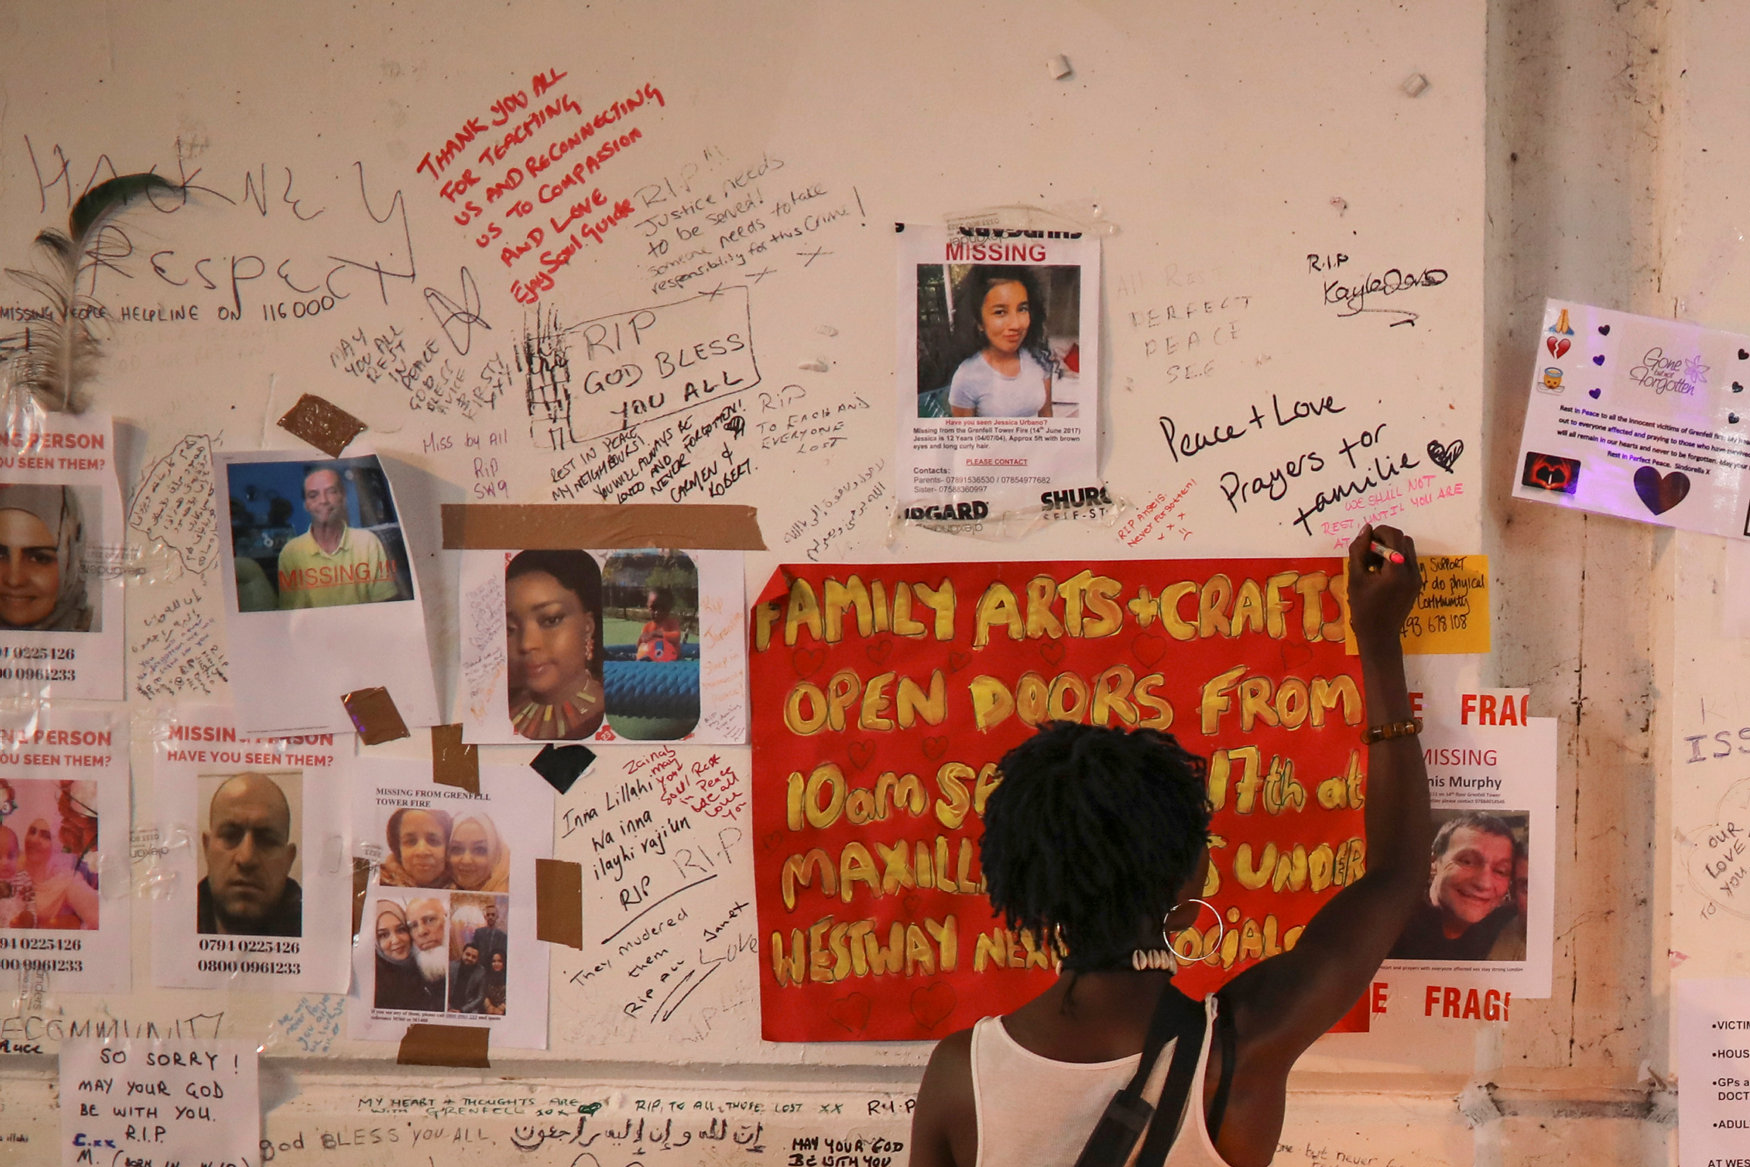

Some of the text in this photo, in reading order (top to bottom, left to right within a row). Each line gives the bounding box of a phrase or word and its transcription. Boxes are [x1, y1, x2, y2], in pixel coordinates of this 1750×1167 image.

[417, 68, 567, 180] THANK YOU ALL
[440, 94, 582, 203] FOR TEACHING
[454, 83, 665, 226] US AND RECONNECTING
[476, 128, 642, 248] US TO COMPASSION
[501, 188, 607, 267] AND LOVE
[945, 242, 1046, 262] MISSING
[1160, 394, 1346, 462] Peace Love
[1220, 451, 1324, 512] Prayers
[756, 575, 953, 650] FAMILY
[785, 665, 1361, 735] OPEN DOORS FROM
[788, 750, 1304, 831] 10am 17th
[1233, 840, 1365, 894] UNDER
[772, 915, 958, 985] WESTWAY
[78, 1078, 223, 1099] MAY YOUR GOD
[100, 1048, 126, 1064] SO
[1718, 1078, 1740, 1087] GPs
[80, 1104, 215, 1121] BE WITH YOU.
[1708, 1160, 1722, 1167] AT
